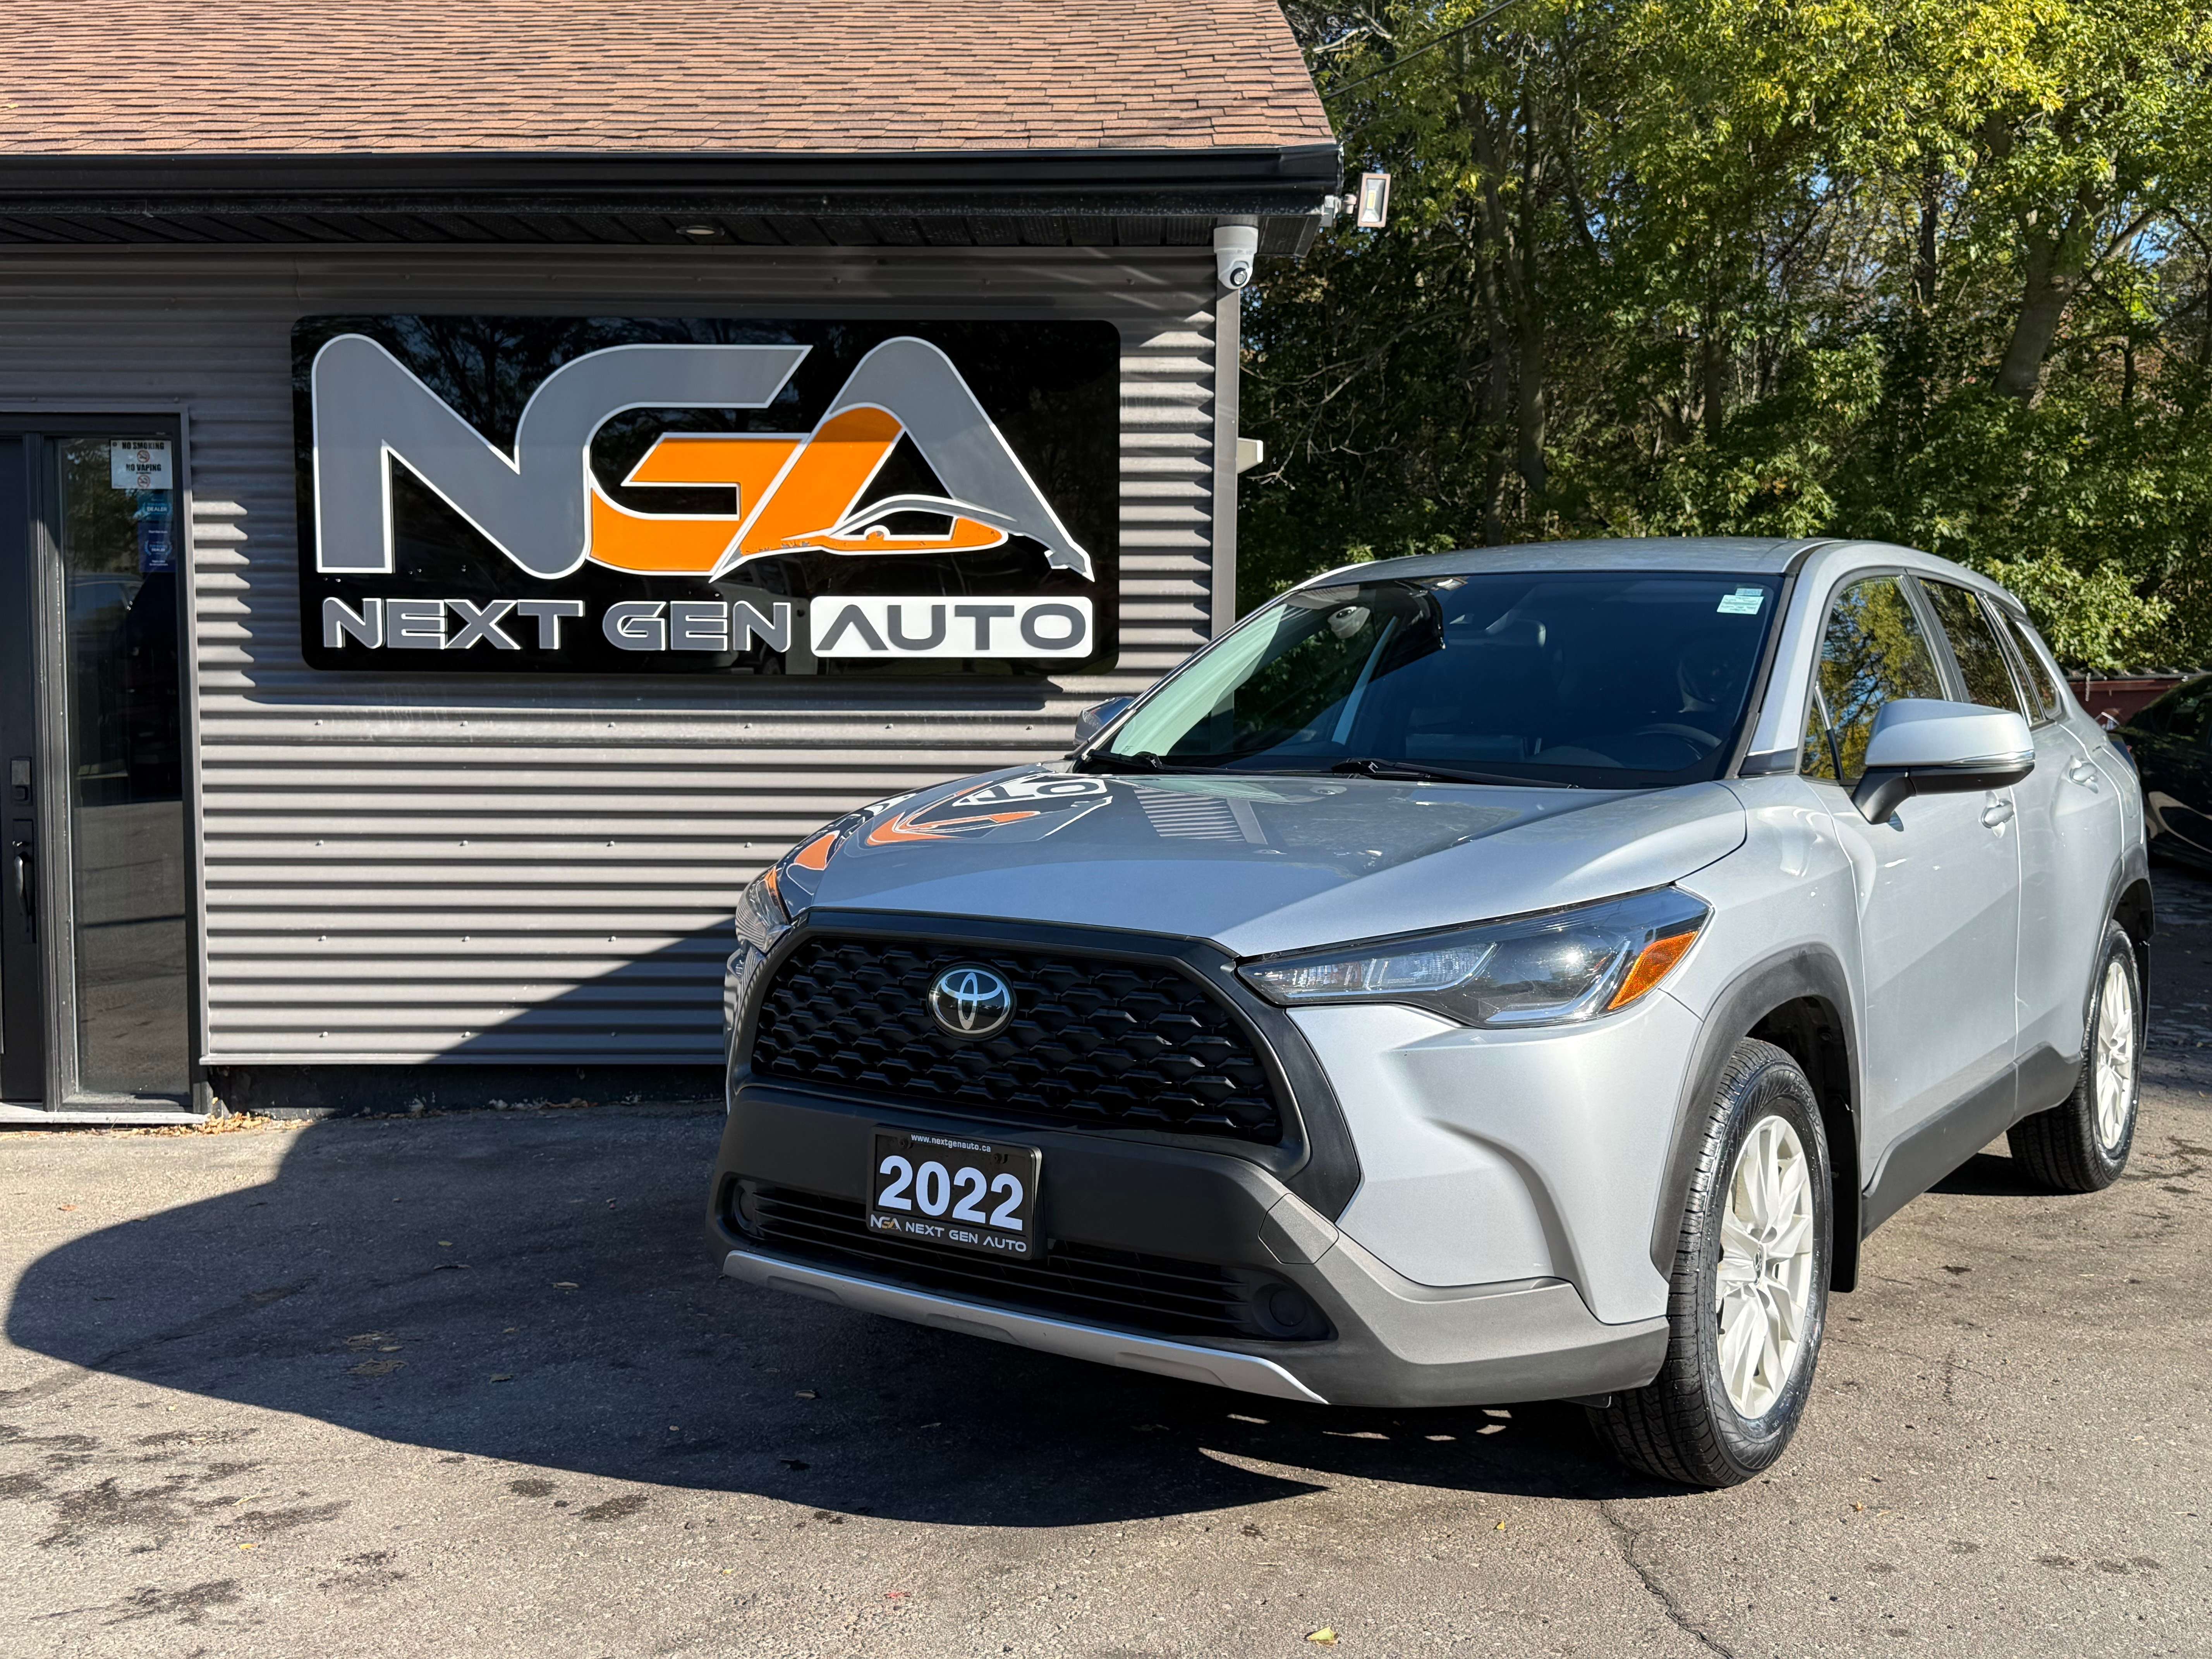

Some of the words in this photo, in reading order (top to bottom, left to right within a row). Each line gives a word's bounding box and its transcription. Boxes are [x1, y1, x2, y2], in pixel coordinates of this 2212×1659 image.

[322, 596, 585, 651] NEXT
[602, 600, 792, 653] GEN
[815, 603, 1086, 651] AUTO
[911, 1134, 991, 1152] www.nextgenauto.ca
[878, 1155, 1023, 1231] 2022
[905, 1221, 945, 1238] NEXT
[949, 1230, 978, 1244] GEN
[983, 1236, 1027, 1253] AUTO
